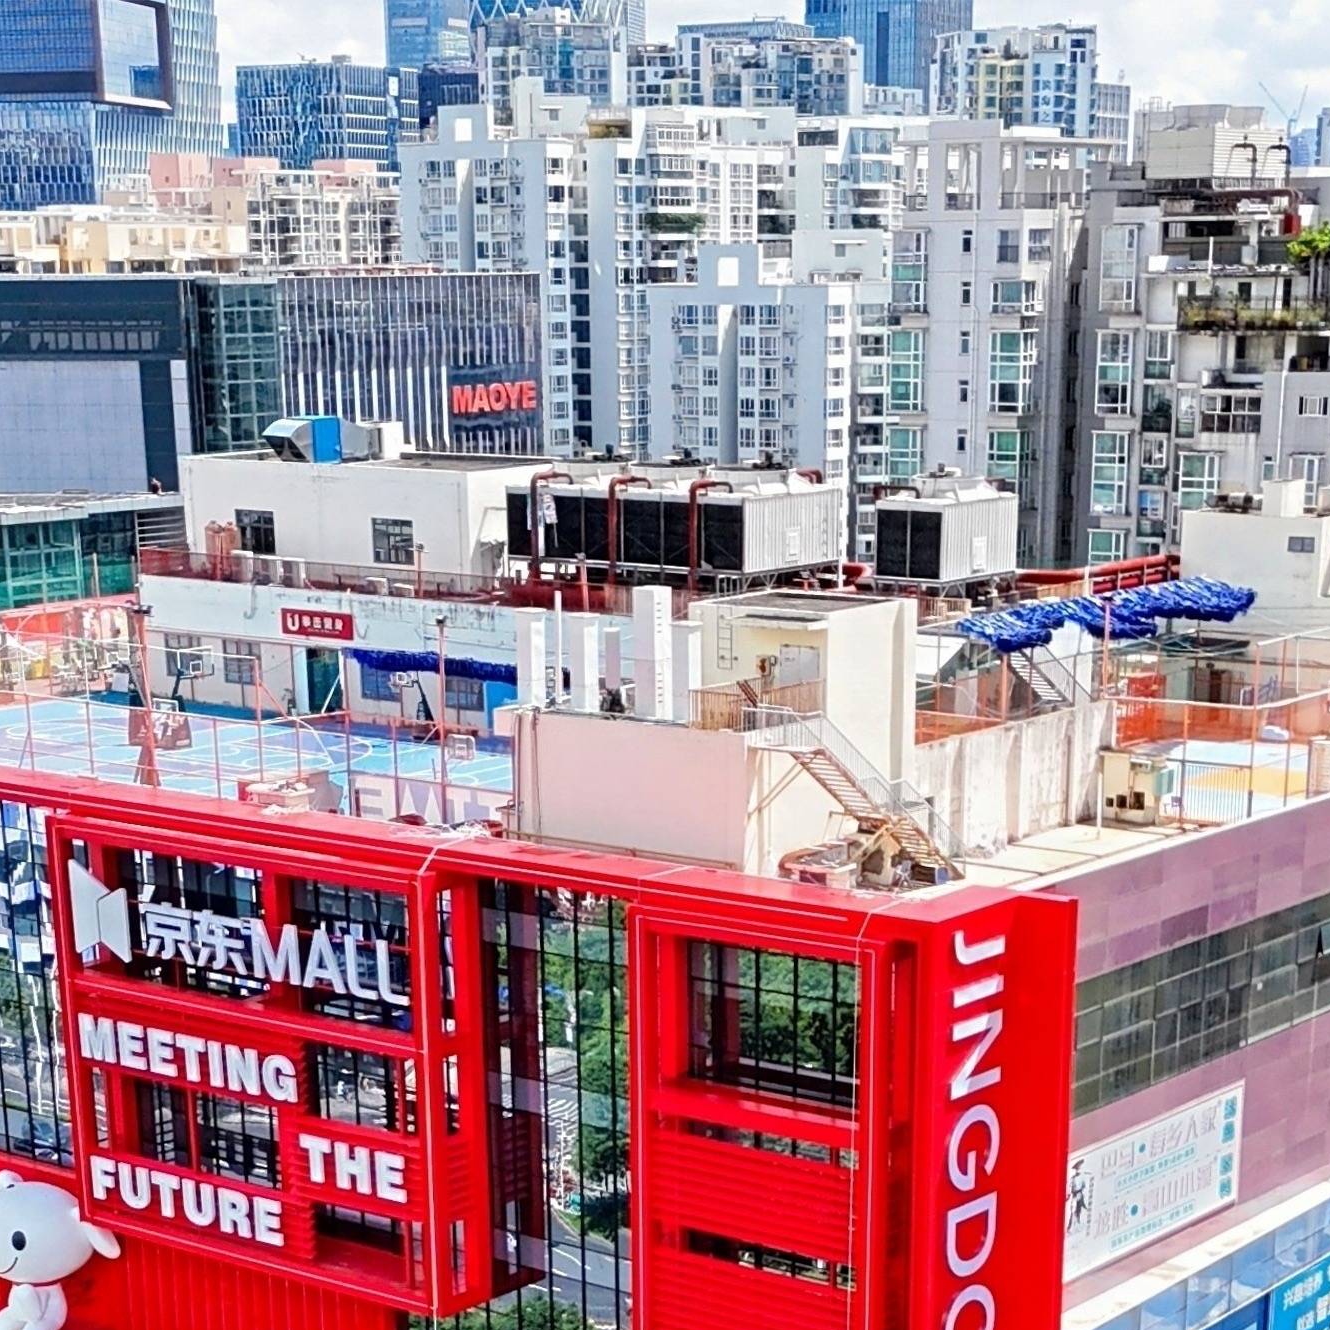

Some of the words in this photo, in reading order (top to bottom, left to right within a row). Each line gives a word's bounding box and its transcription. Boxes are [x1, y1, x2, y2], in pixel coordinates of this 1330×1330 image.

[452, 381, 537, 414] MAOYE
[141, 901, 411, 1006] 京东MALL
[77, 1012, 299, 1103] MEETING
[89, 1155, 286, 1247] FUTURE
[299, 1133, 408, 1204] THE
